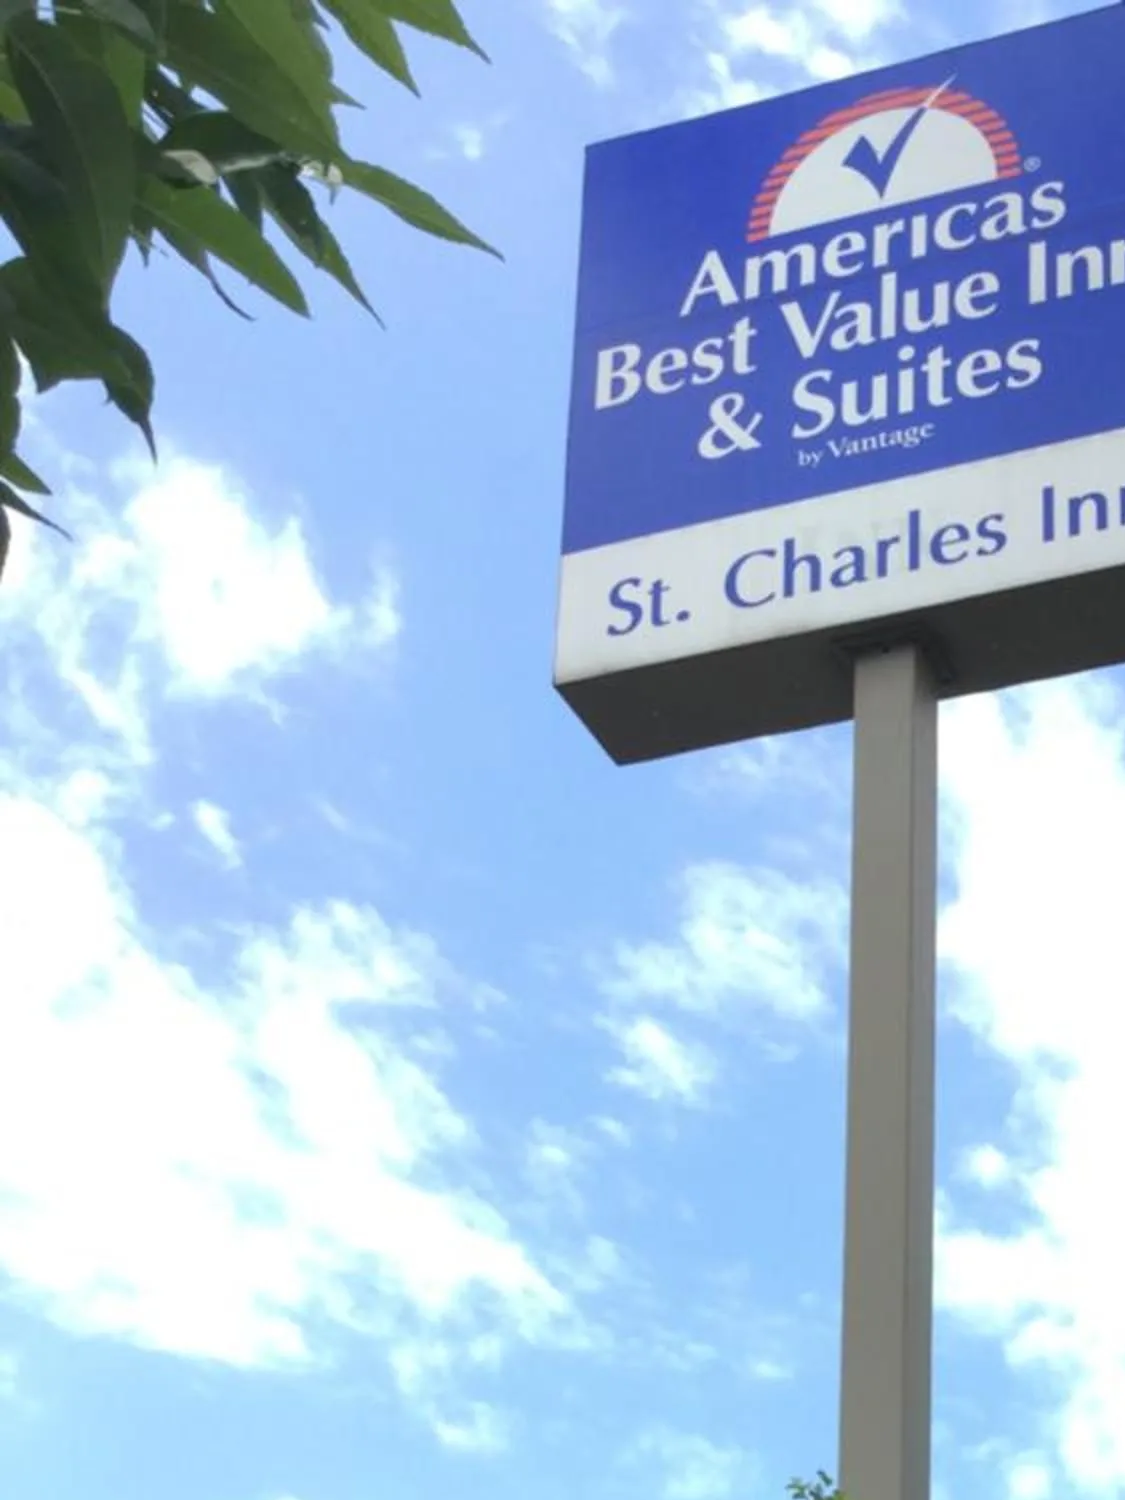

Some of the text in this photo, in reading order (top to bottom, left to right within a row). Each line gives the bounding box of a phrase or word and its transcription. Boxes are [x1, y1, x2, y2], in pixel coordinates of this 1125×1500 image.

[680, 180, 1067, 316] Americas
[594, 317, 757, 409] Best
[781, 273, 999, 359] Value
[698, 336, 1042, 459] & Suites
[798, 422, 935, 467] by Vantage
[606, 577, 691, 637] St.
[723, 510, 1007, 608] Charles
